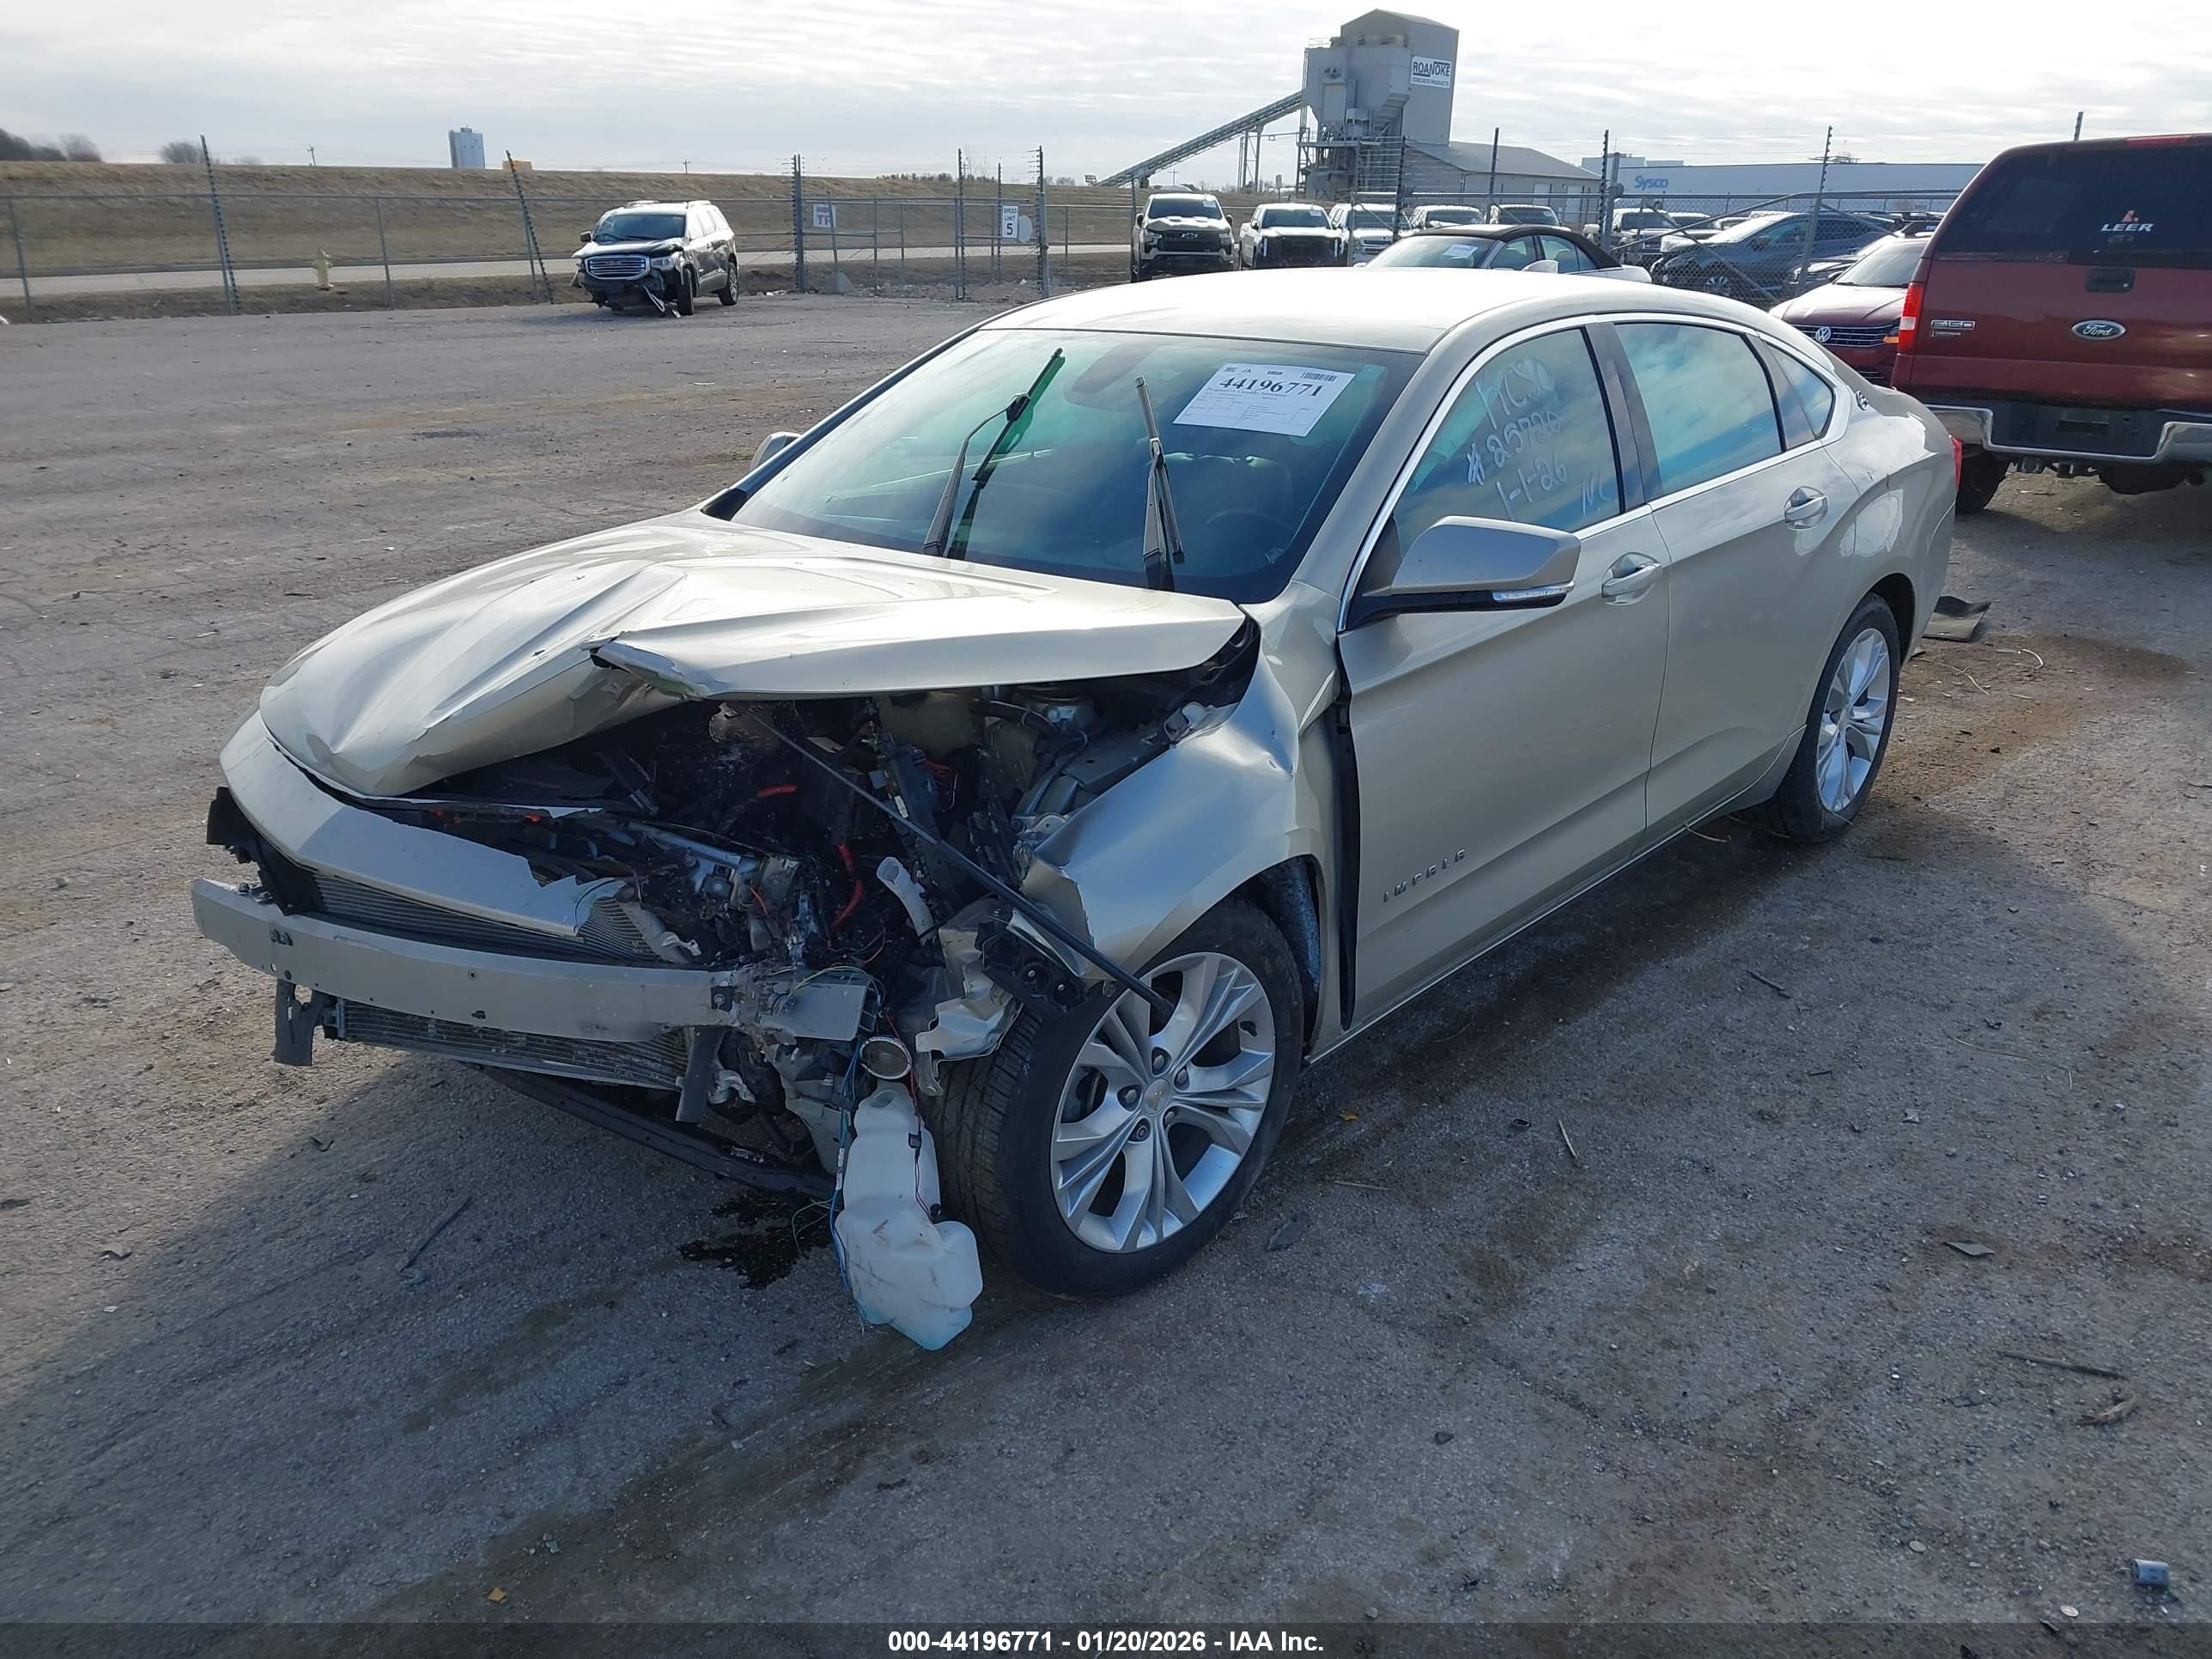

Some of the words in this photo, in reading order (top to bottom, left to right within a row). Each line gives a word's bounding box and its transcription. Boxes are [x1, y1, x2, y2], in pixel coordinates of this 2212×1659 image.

[1413, 61, 1450, 76] ROANOKE
[1634, 175, 1668, 191] Sysco
[1006, 222, 1013, 235] 5
[2101, 223, 2154, 232] LEER
[2082, 324, 2113, 336] Ford
[1219, 377, 1323, 397] 44196771
